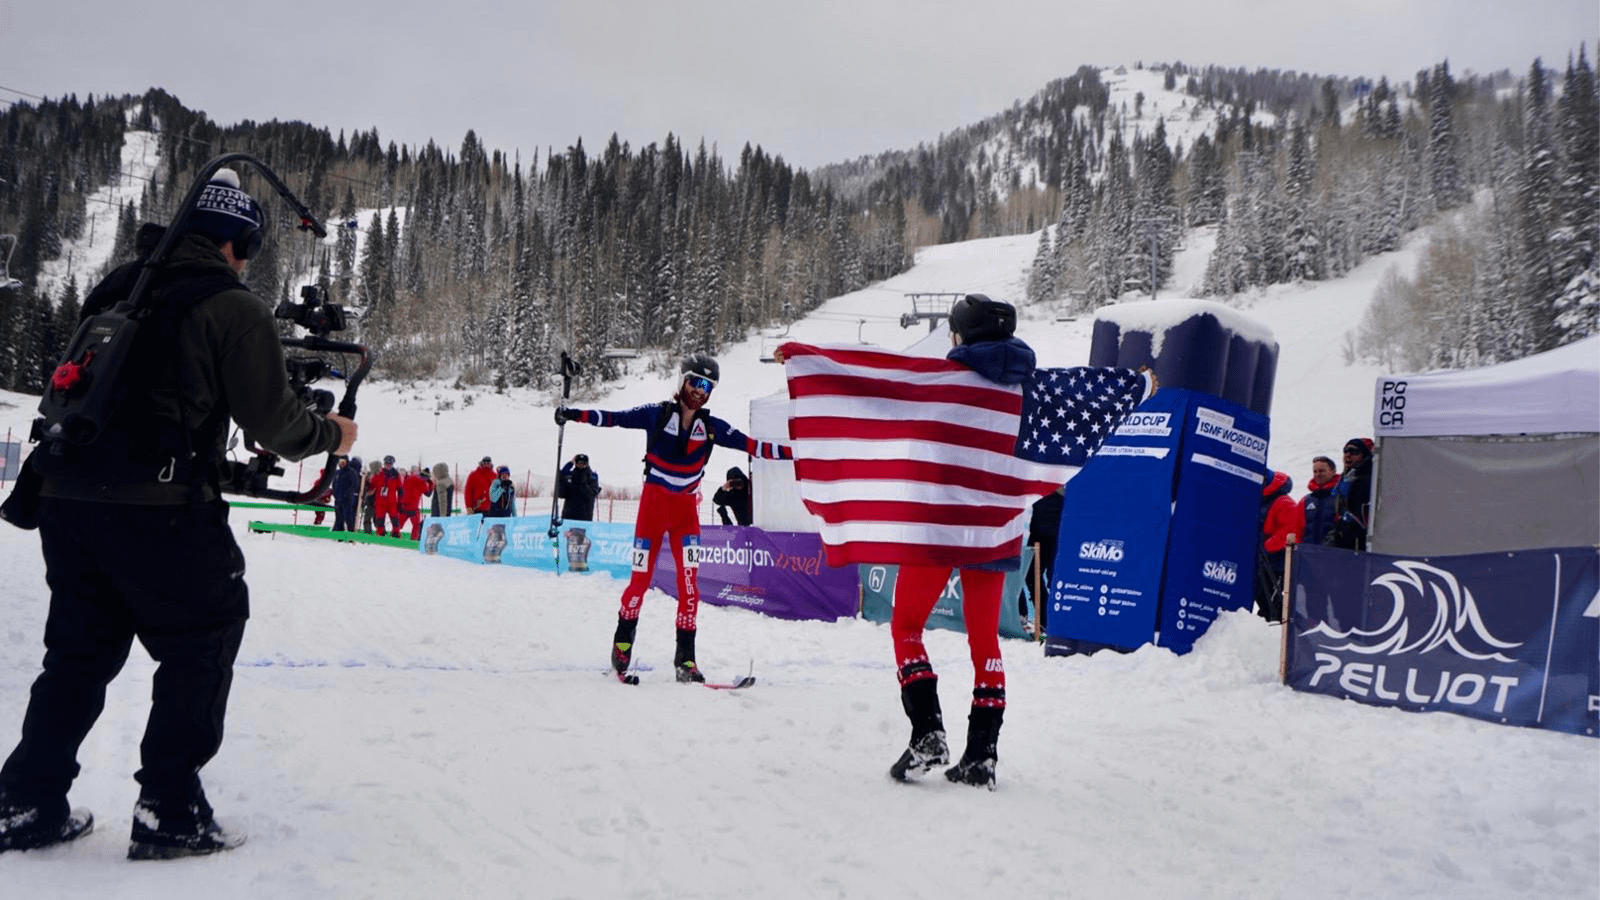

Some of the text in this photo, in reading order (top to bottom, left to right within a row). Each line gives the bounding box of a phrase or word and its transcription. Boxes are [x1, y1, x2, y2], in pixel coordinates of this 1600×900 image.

[200, 194, 251, 211] BEFORE
[203, 188, 251, 203] PLANTS
[1122, 415, 1166, 426] RLD CUP
[1200, 422, 1266, 451] ISMF WORLD CUP
[699, 541, 822, 576] azerbaijan travel
[1080, 542, 1123, 561] SkiMo
[1203, 561, 1237, 584] SkiMo
[1308, 652, 1519, 713] PELLIOT
